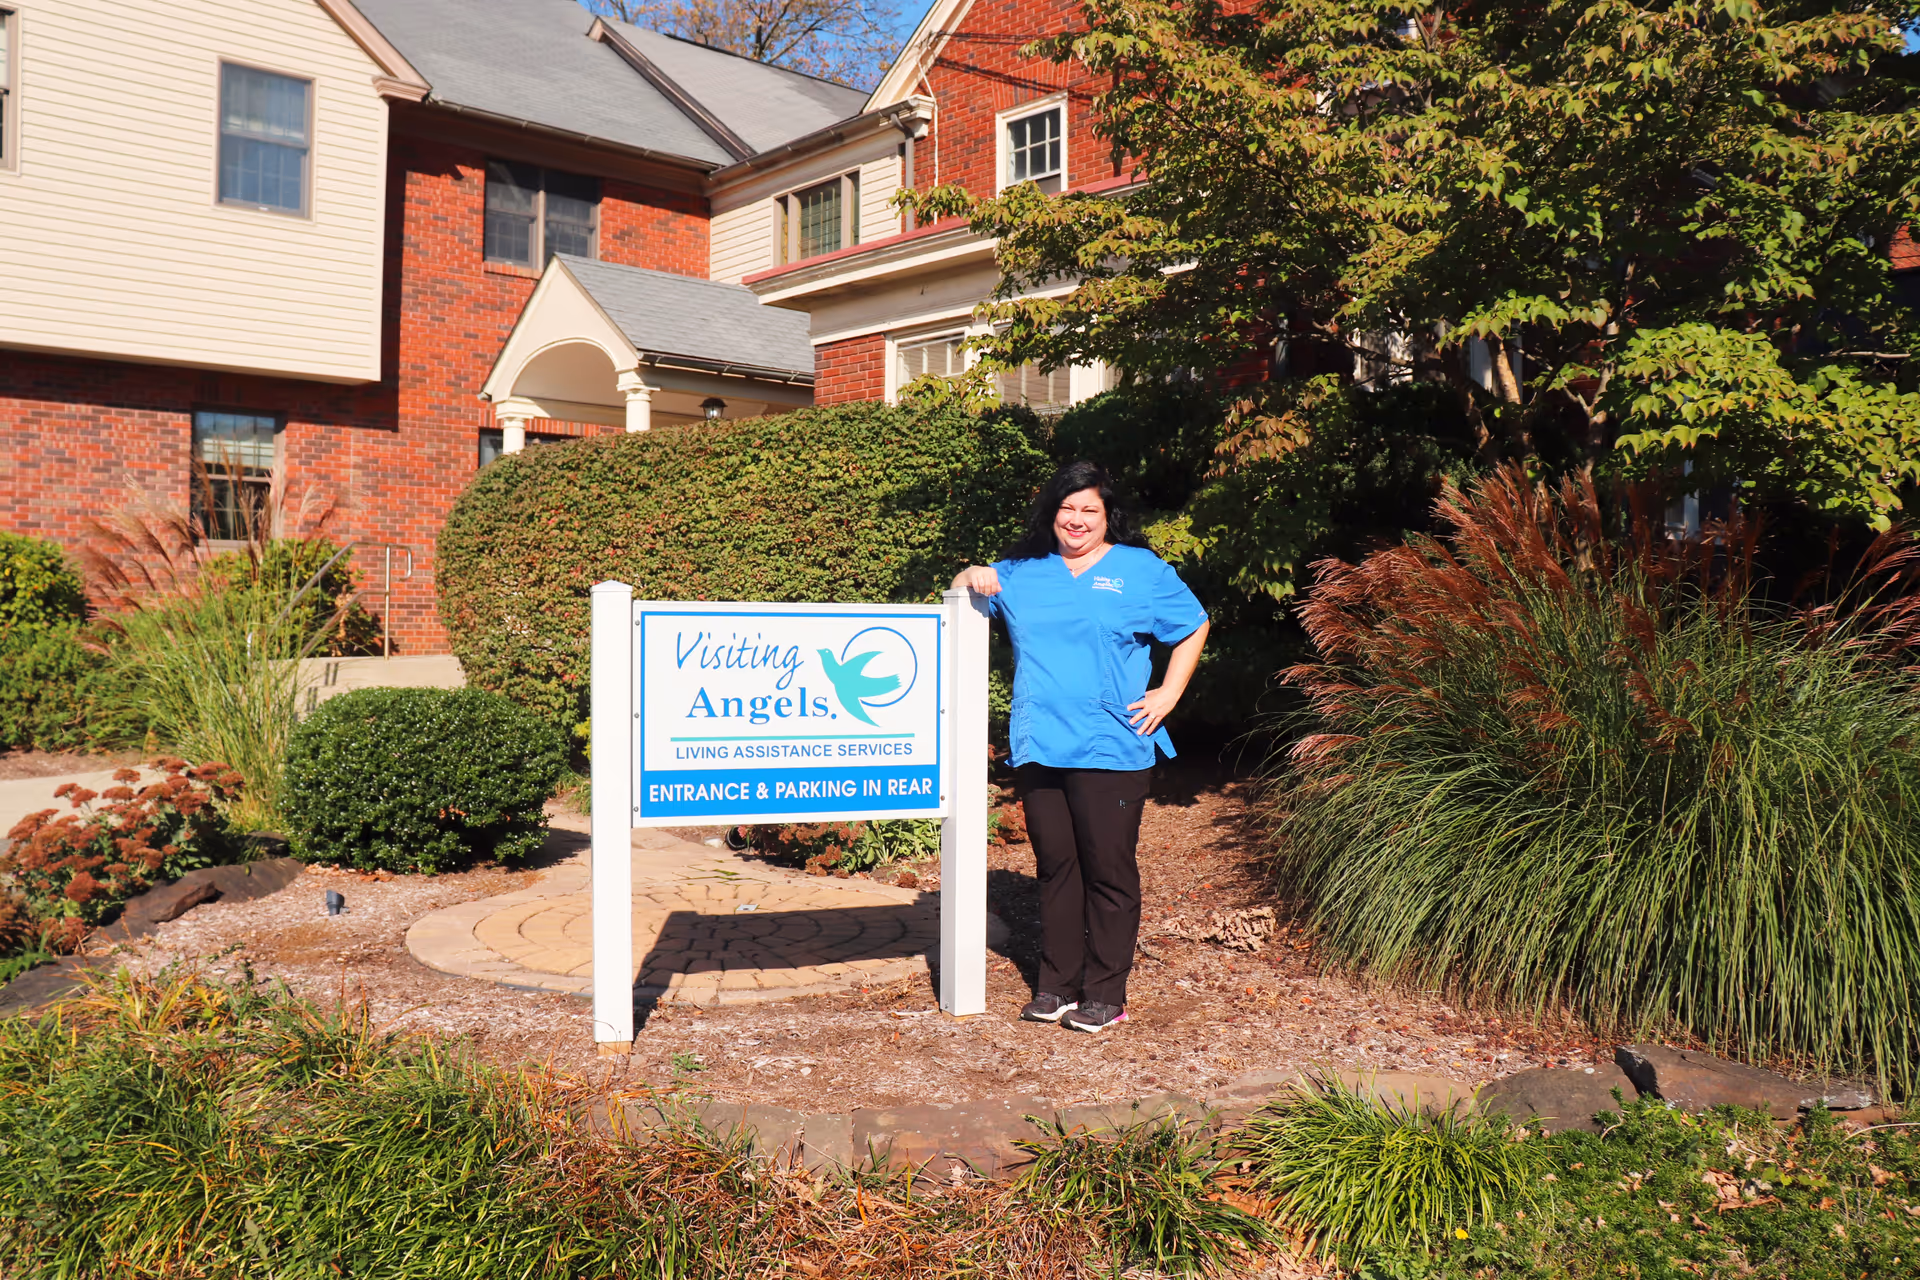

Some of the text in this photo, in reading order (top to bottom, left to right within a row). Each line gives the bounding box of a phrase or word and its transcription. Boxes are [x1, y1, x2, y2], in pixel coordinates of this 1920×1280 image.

[676, 631, 804, 690] Visiting
[676, 743, 913, 760] LIVING ASSISTANCE SERVICES
[649, 778, 933, 802] ENTRANCE & PARKING IN REAR
